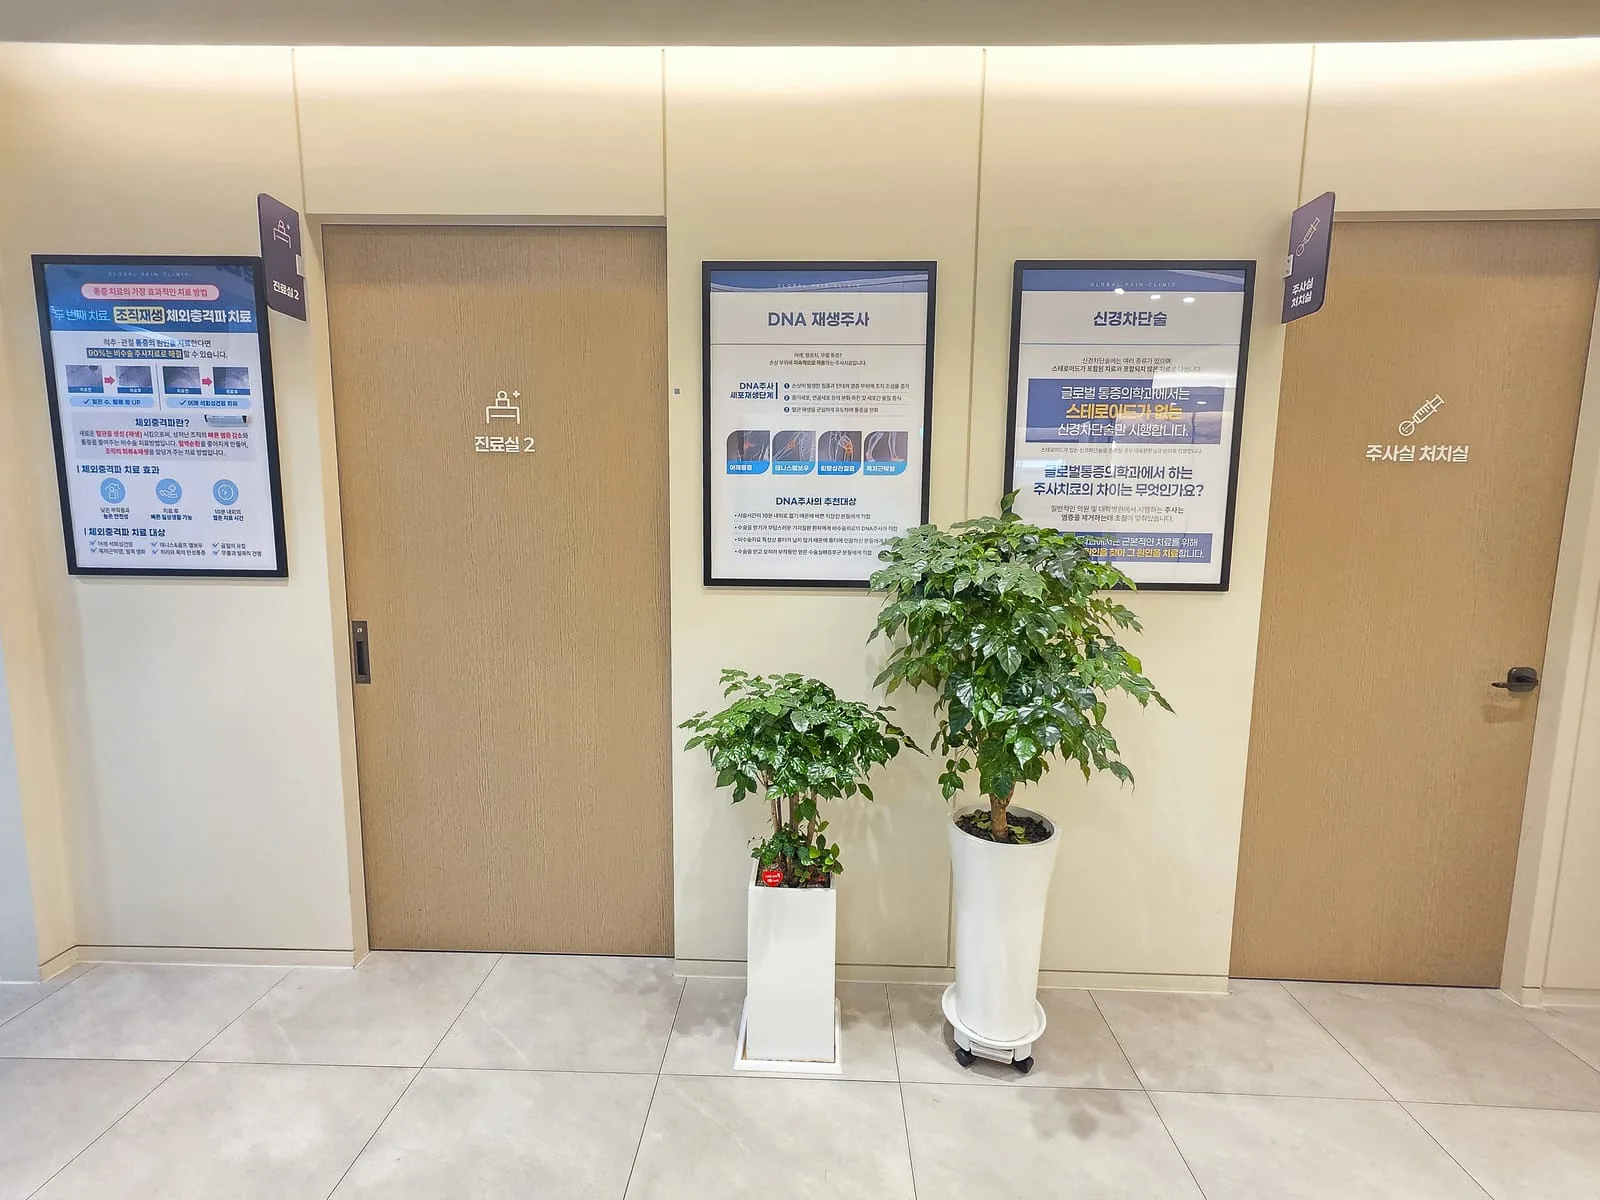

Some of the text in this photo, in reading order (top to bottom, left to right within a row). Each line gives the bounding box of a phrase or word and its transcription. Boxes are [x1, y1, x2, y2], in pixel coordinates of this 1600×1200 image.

[93, 288, 208, 297] 통증 치료의 가장 효과적인 치료 방법
[273, 280, 300, 300] 진료실 2
[1292, 277, 1314, 295] 주사실
[1290, 290, 1312, 309] 처치실
[65, 309, 87, 321] 번째
[116, 309, 162, 322] 조직재생
[166, 309, 227, 323] 체외충격파
[228, 310, 252, 323] 치료
[768, 312, 870, 327] DNA 재생주사
[1094, 311, 1168, 327] 신경차단술
[192, 350, 199, 358] 수
[200, 350, 228, 359] 있습니다.
[739, 382, 774, 390] DNA주사
[730, 391, 774, 399] 세포재생단계
[1061, 387, 1191, 400] 글로벌 통증의학과에서는
[1066, 403, 1183, 420] 스테로이드가 없는
[135, 418, 190, 427] 체외충격파란?
[1058, 424, 1189, 437] 신경차단술만 시행합니다.
[474, 436, 536, 453] 진료실 2
[1365, 444, 1470, 462] 주사실 처치실
[81, 465, 160, 475] 체외충격파 치료 효과
[1044, 465, 1193, 480] 글로벌통증의학과에서 하는
[1033, 483, 1204, 498] 주사치료의 차이는 무엇인가요?
[775, 497, 857, 506] DNA주사의 추천대상
[89, 528, 166, 537] 체외충격파 치료 대상
[1122, 537, 1155, 547] 근본적인
[1156, 538, 1180, 547] 치료를
[1181, 538, 1198, 547] 위해
[1127, 548, 1135, 557] 그
[1136, 548, 1161, 558] 원인을
[1162, 549, 1205, 559] 치료합니다.
